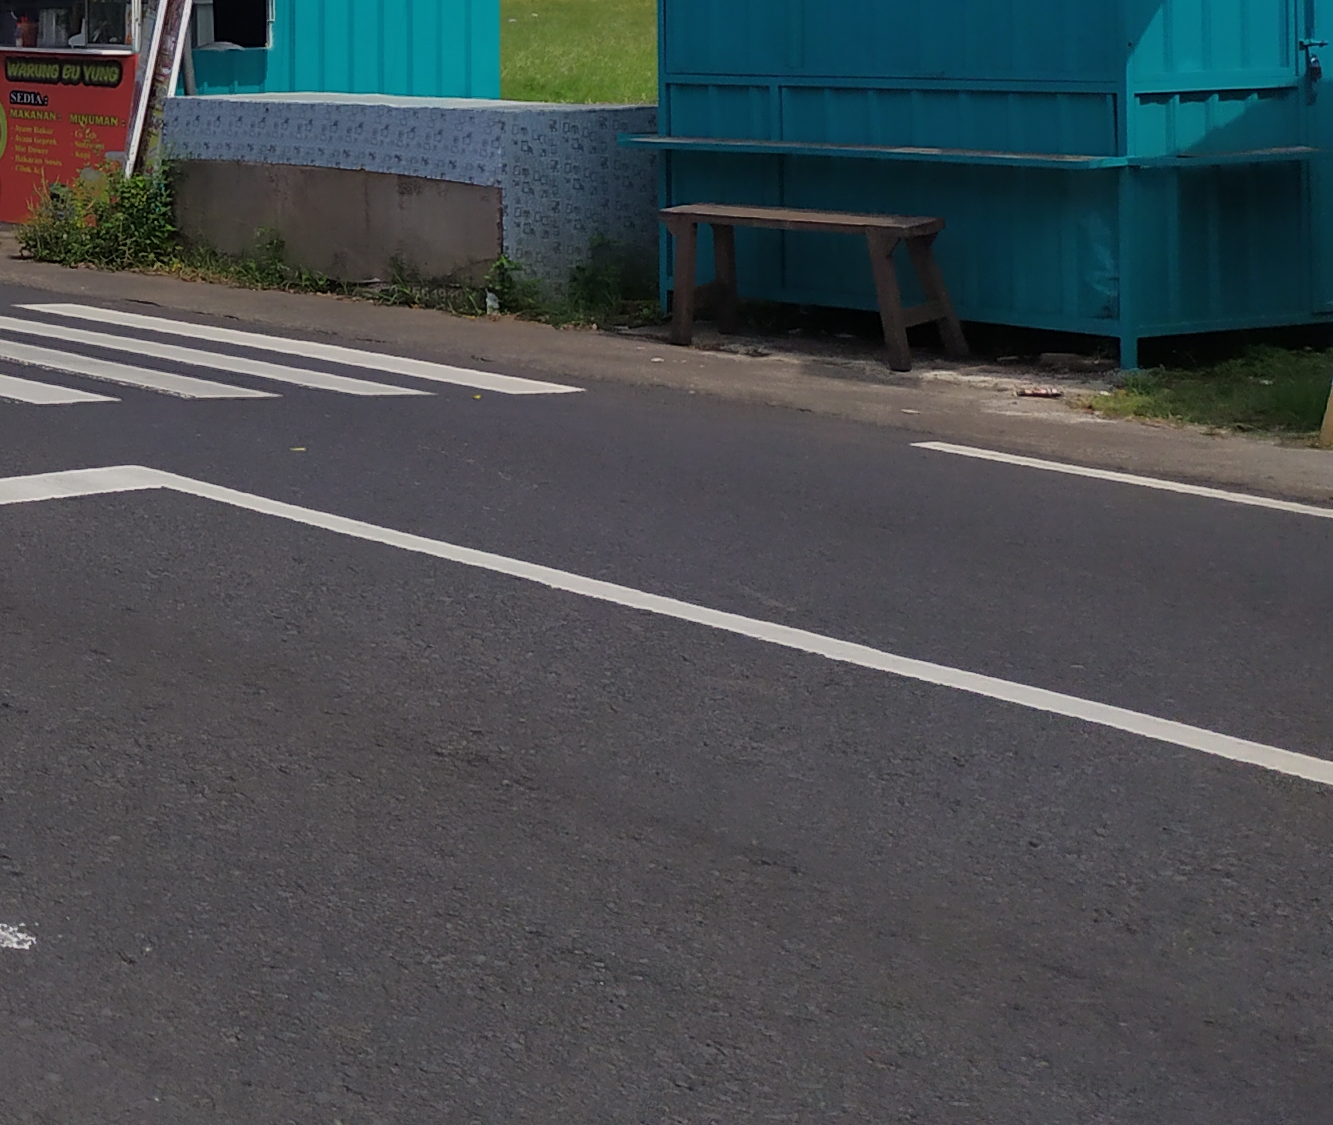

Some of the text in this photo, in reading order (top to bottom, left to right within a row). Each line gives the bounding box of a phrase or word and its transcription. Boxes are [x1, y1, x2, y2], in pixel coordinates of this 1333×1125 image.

[6, 60, 121, 82] WARUNG BU YUNG
